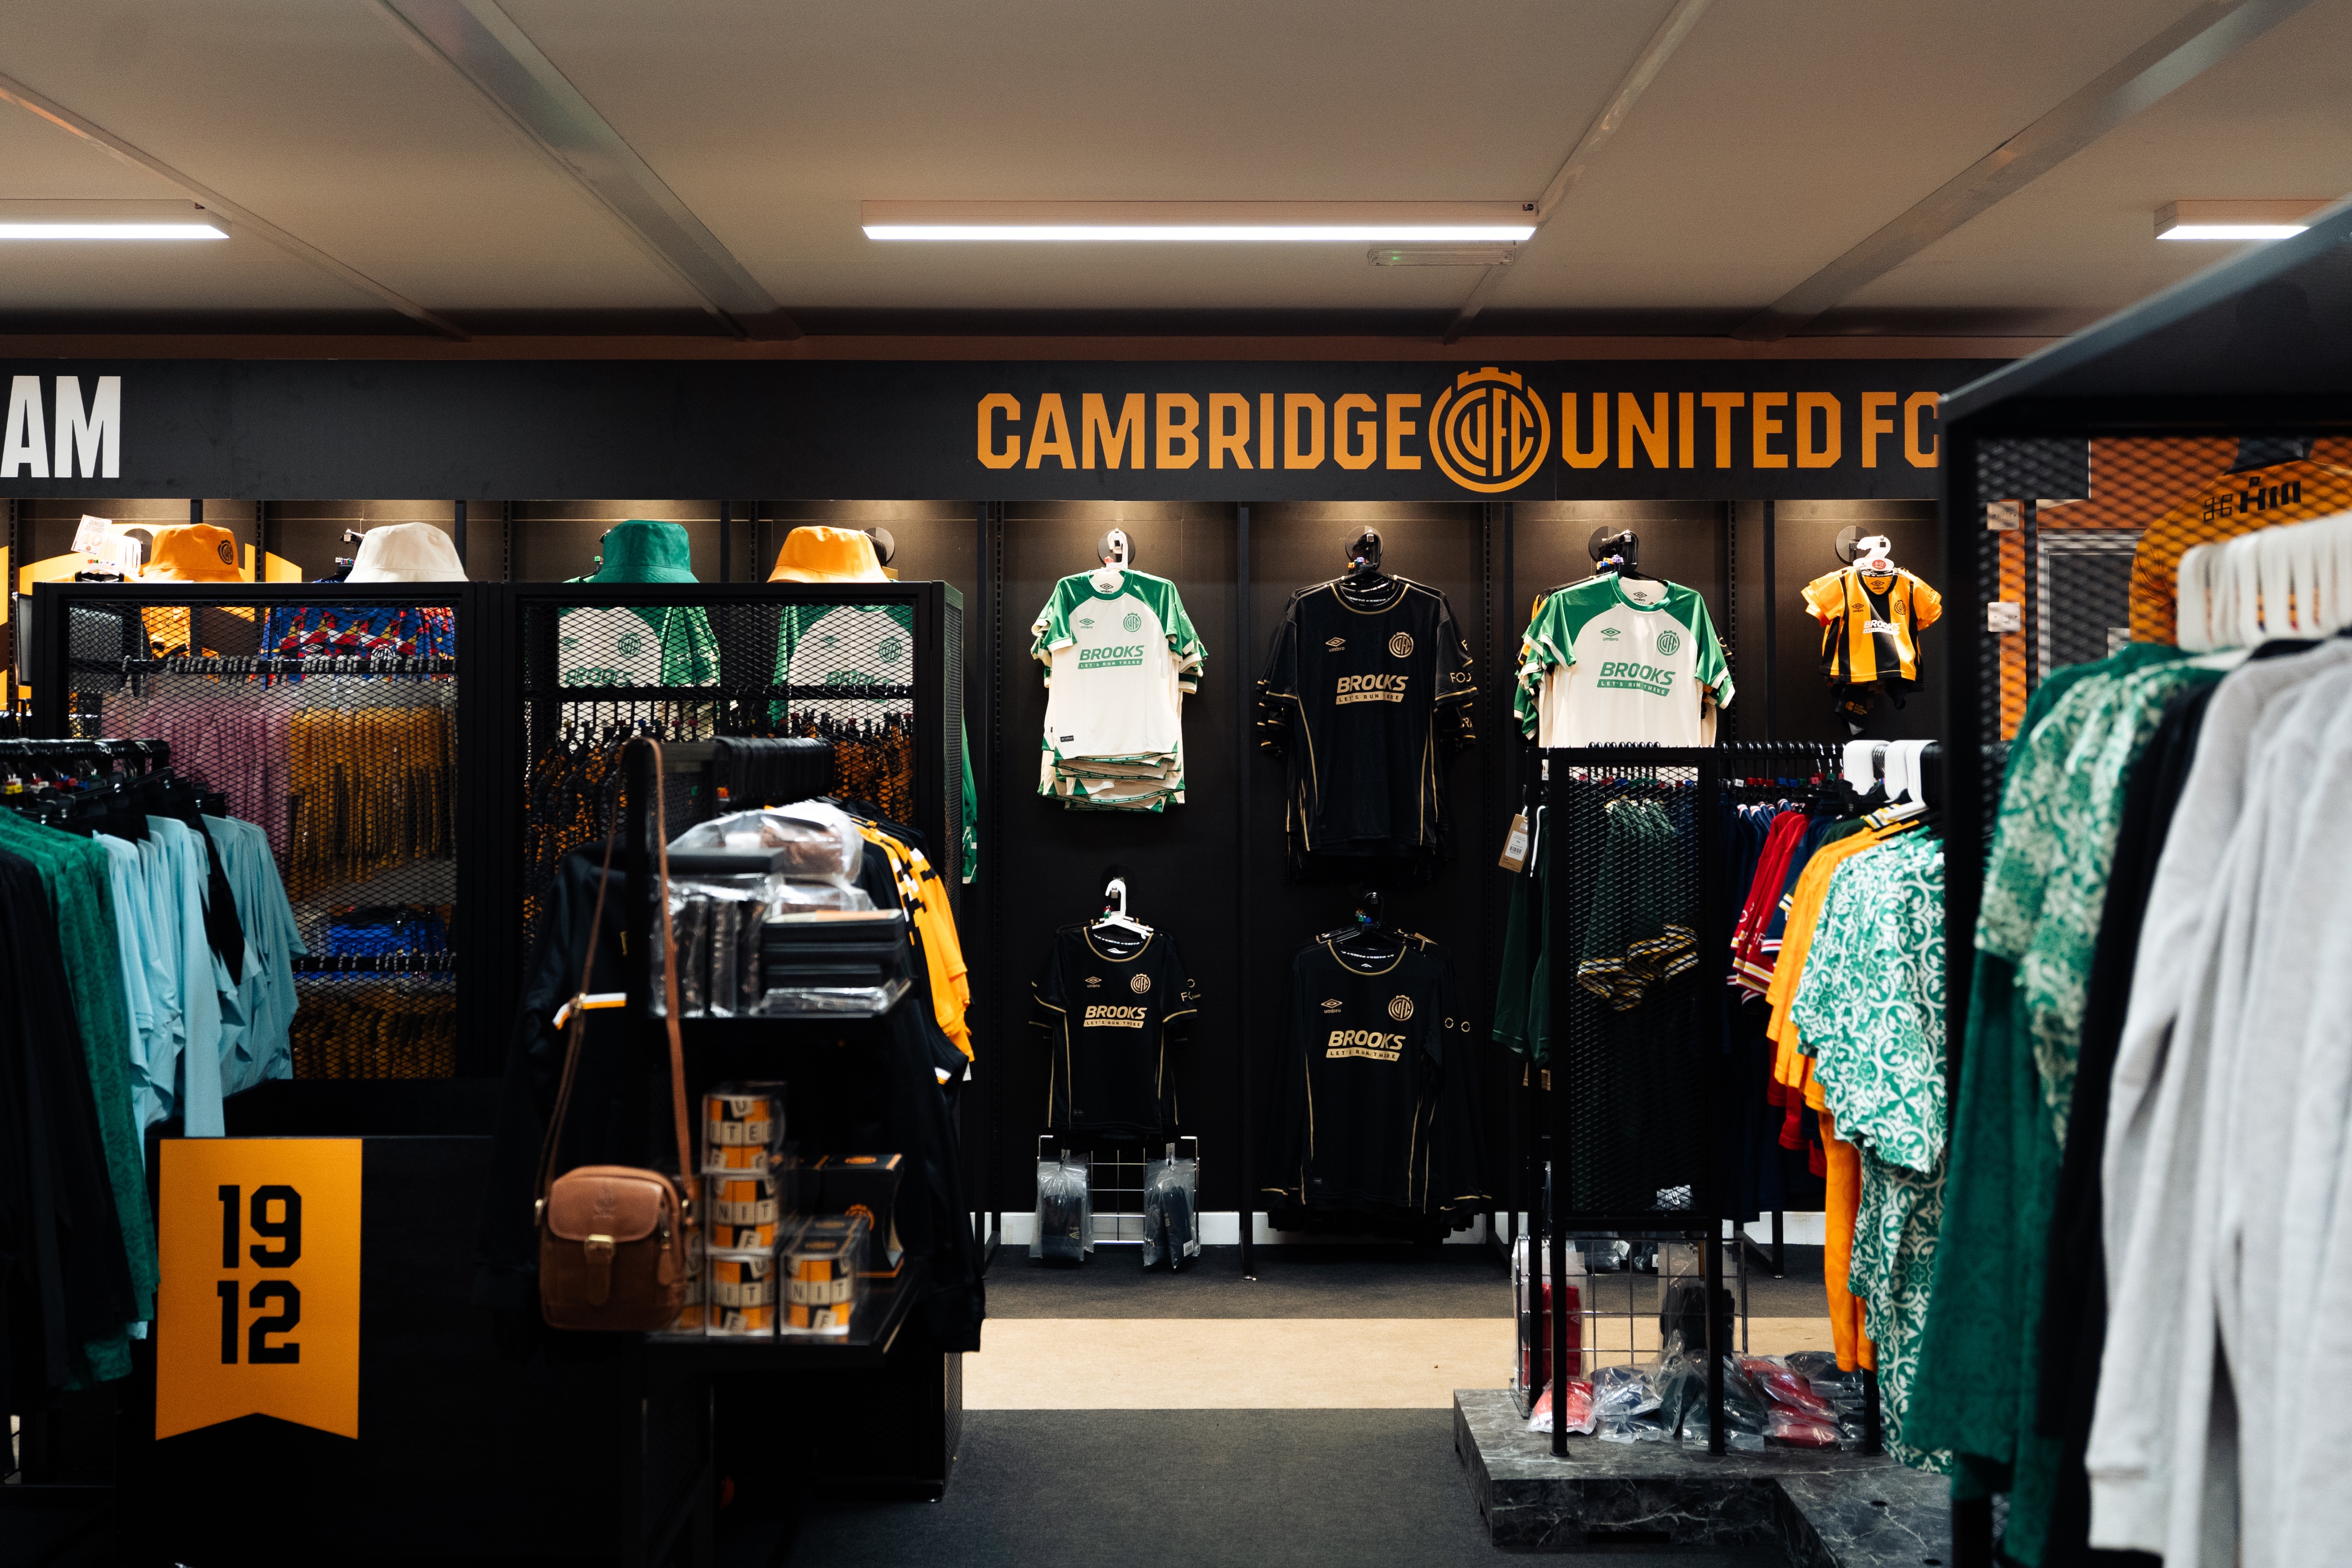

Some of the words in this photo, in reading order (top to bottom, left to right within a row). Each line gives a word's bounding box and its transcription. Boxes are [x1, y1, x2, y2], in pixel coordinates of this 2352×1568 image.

[977, 392, 1421, 469] CAMBRIDGE
[1561, 392, 1841, 468] UNITED
[1862, 392, 1940, 468] FC
[88, 519, 105, 528] JUNIOR
[1863, 620, 1900, 631] BROOKS
[1079, 645, 1145, 661] BROOKS
[1600, 662, 1676, 685] BROOKS
[1644, 684, 1665, 694] THERE
[1085, 1005, 1148, 1019] BROOKS
[1328, 1029, 1406, 1050] BROOKS
[218, 1185, 302, 1268] 19
[217, 1280, 301, 1364] 12
